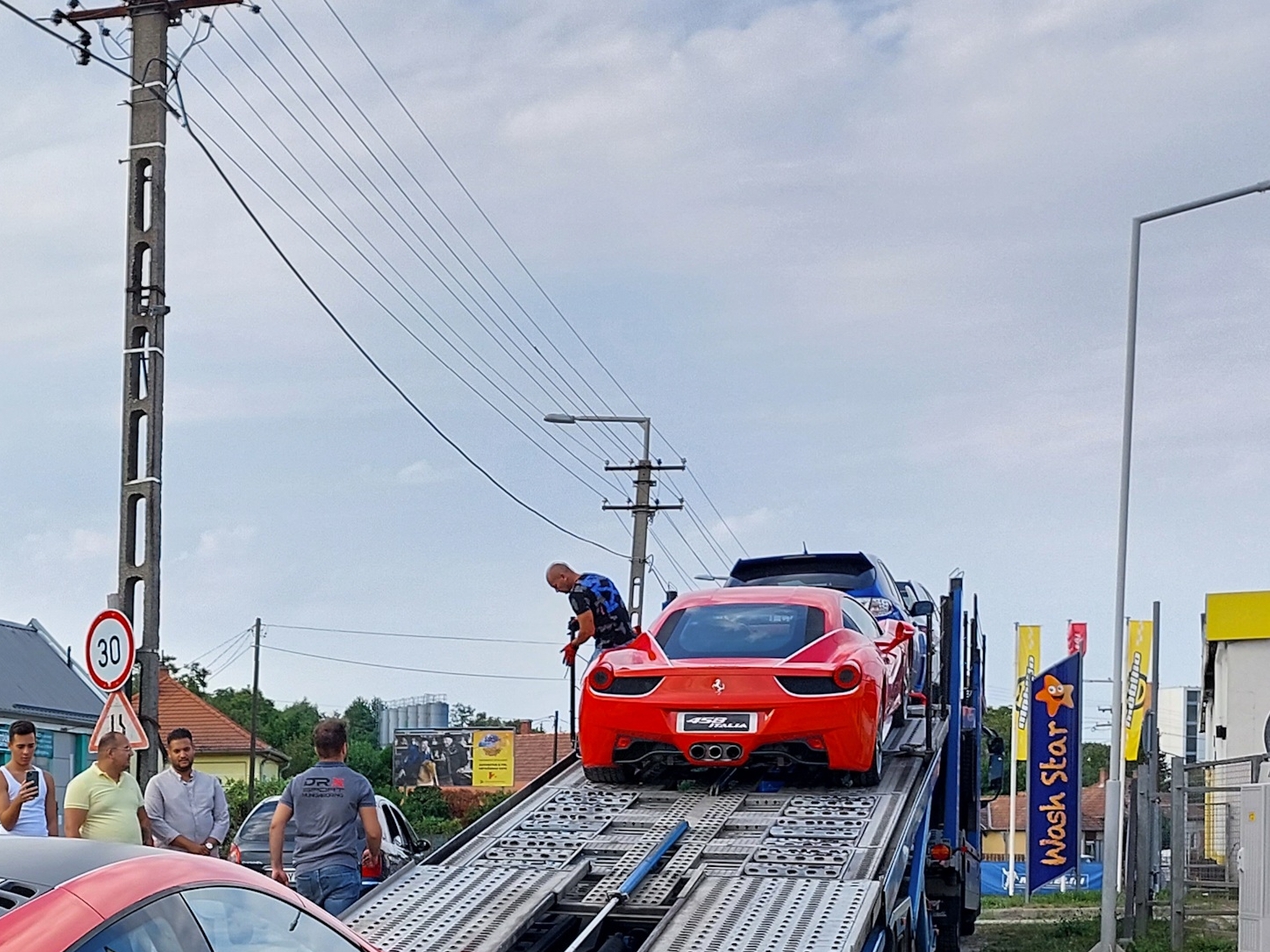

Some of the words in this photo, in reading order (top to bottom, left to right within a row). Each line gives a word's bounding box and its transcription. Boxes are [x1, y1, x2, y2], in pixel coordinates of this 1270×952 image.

[97, 635, 121, 668] 30
[1038, 720, 1069, 786] Star
[1038, 791, 1067, 866] Wash
